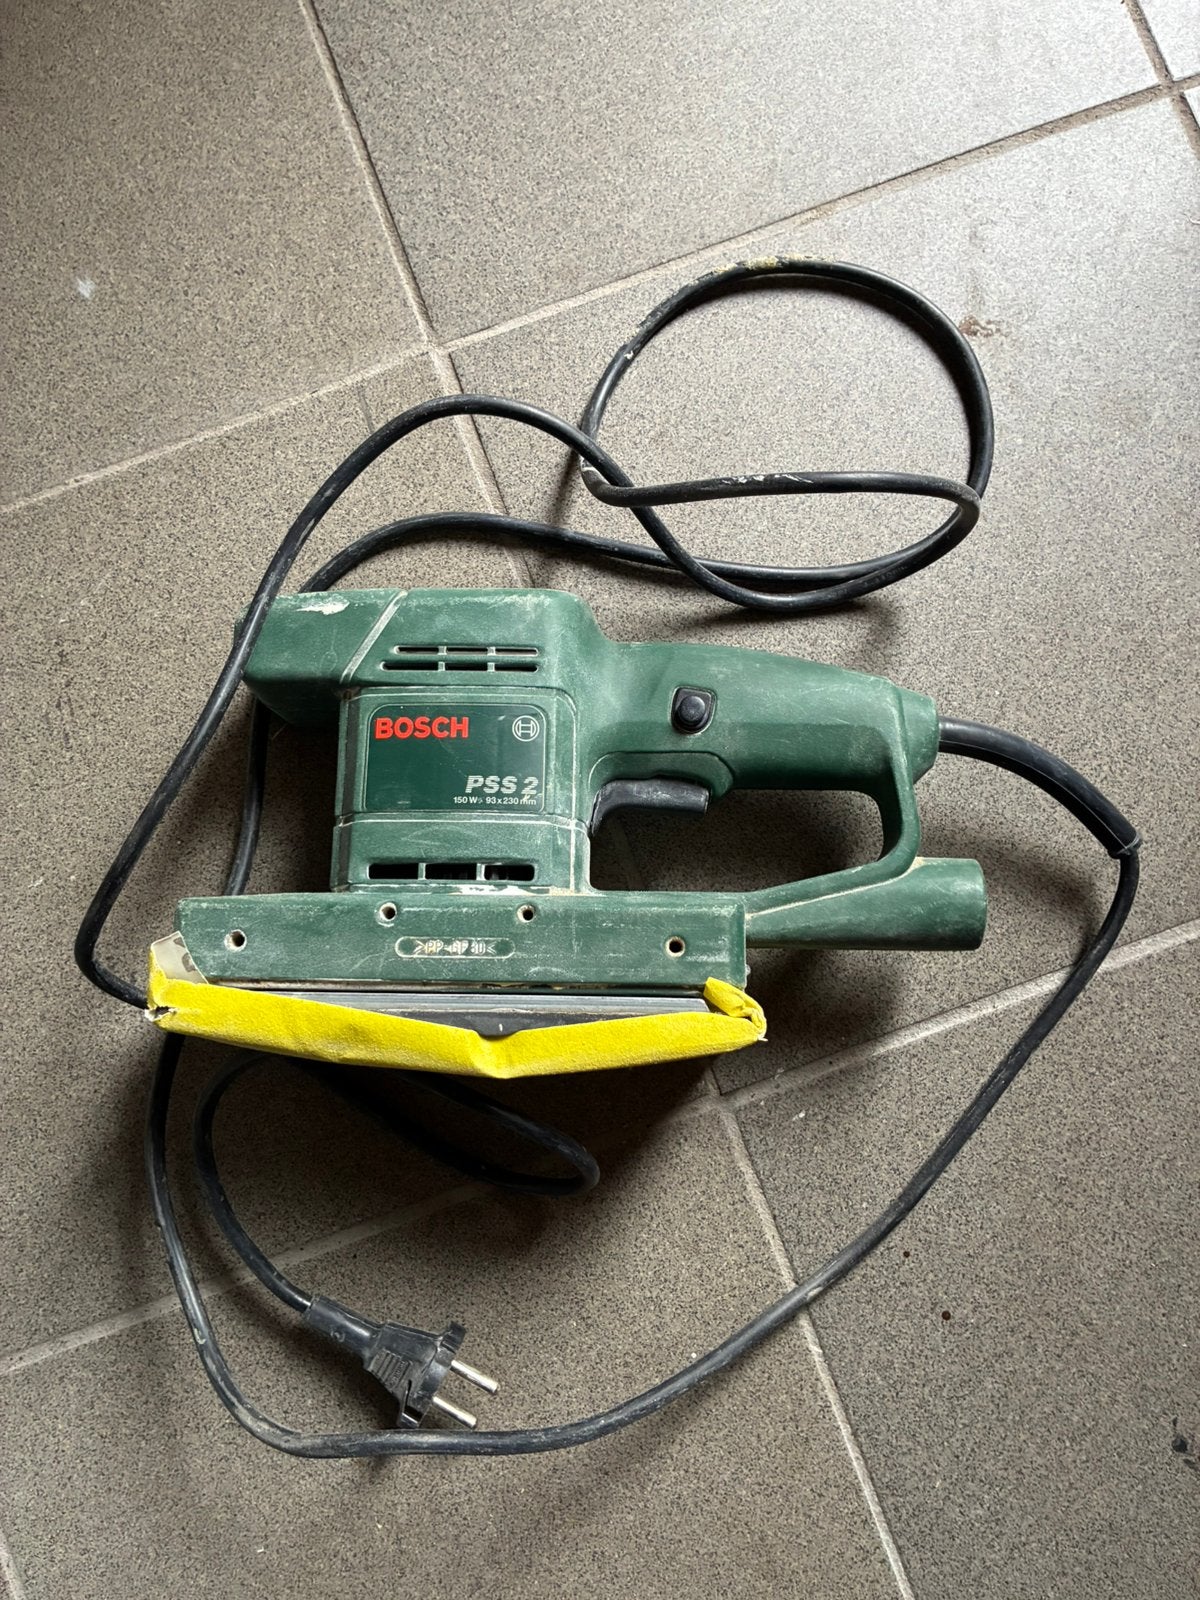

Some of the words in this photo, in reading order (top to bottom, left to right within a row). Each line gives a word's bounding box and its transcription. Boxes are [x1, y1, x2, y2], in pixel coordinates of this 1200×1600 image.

[375, 716, 469, 740] BOSCH
[465, 775, 518, 794] PSS
[521, 776, 539, 795] 2
[453, 796, 468, 804] 150
